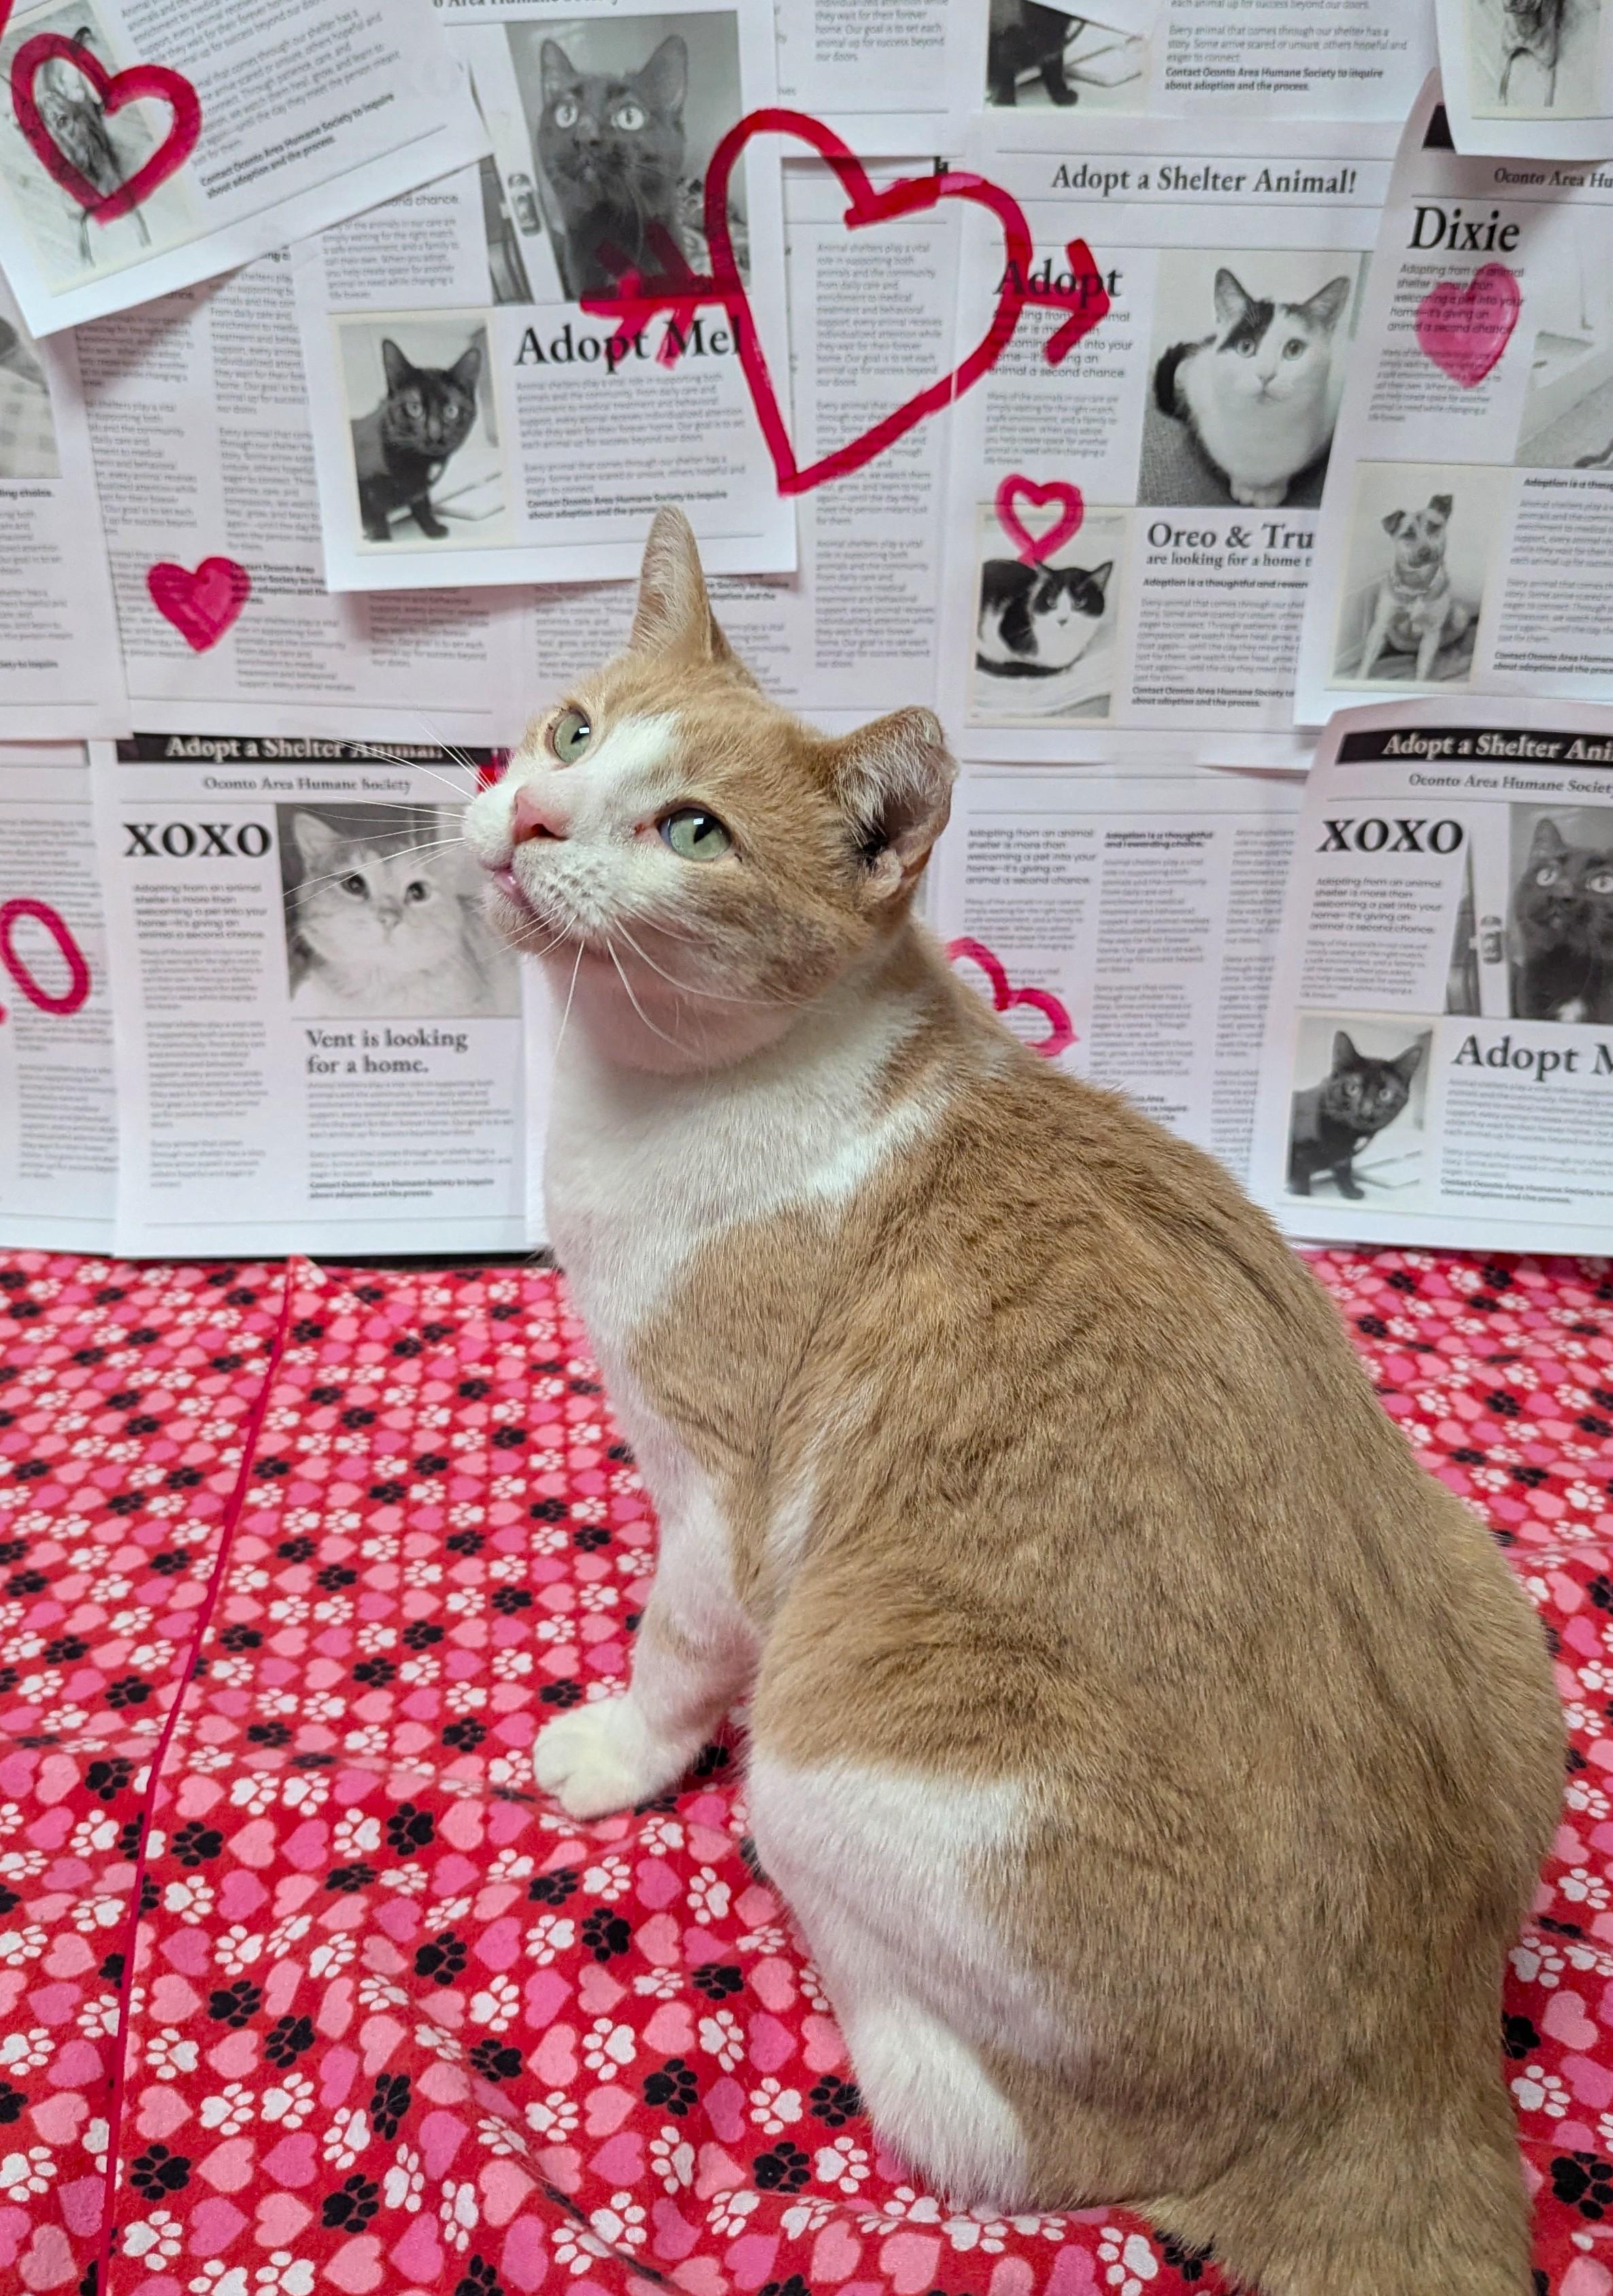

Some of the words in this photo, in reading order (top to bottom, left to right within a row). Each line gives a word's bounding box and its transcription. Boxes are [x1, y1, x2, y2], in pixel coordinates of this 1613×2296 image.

[1165, 68, 1201, 77] Contact
[1204, 69, 1236, 77] Oconto
[1238, 69, 1259, 77] Area
[1261, 69, 1301, 78] Humane
[1303, 69, 1335, 80] Society
[1337, 70, 1346, 78] to
[1165, 80, 1192, 90] about
[1194, 80, 1235, 92] adoption
[1237, 81, 1254, 90] and
[1257, 81, 1271, 90] the
[1051, 164, 1130, 197] Adopt
[1137, 174, 1148, 190] a
[1159, 167, 1246, 192] Shelter
[1252, 170, 1357, 195] Animal!
[1494, 168, 1544, 184] Oconto
[1548, 171, 1584, 187] Area
[1406, 206, 1520, 252] Dixie
[1400, 264, 1446, 277] Adopting
[1448, 266, 1470, 275] from
[992, 258, 1123, 308] Adopt
[514, 324, 651, 375] Adopt
[1084, 339, 1105, 349] into
[1108, 341, 1133, 353] your
[1084, 354, 1099, 363] an
[1040, 367, 1080, 377] second
[1147, 522, 1217, 548] Oreo
[1225, 526, 1252, 549] &
[1261, 522, 1314, 550] Tru
[1146, 555, 1167, 565] are
[1171, 552, 1223, 570] looking
[1227, 553, 1248, 567] for
[1250, 558, 1259, 567] a
[1263, 554, 1301, 567] home
[1143, 578, 1186, 589] Adoption
[1205, 579, 1255, 590] thoughtful
[1257, 580, 1276, 589] and
[1132, 686, 1163, 694] Contact
[1196, 687, 1215, 696] Area
[1217, 688, 1253, 696] Humane
[1254, 688, 1284, 698] Society
[1131, 696, 1155, 705] about
[1157, 696, 1194, 707] adoption
[1195, 698, 1212, 706] and
[1212, 698, 1227, 707] the
[165, 735, 241, 763] Adopt
[244, 742, 258, 758] a
[262, 737, 342, 758] Shelter
[1382, 732, 1452, 761] Adopt
[1458, 739, 1473, 755] a
[1476, 734, 1563, 759] Shelter
[203, 777, 256, 790] Oconto
[263, 777, 293, 790] Area
[299, 778, 357, 791] Humane
[362, 778, 412, 794] Society
[1409, 773, 1461, 787] Oconto
[1465, 775, 1498, 788] Area
[1502, 776, 1563, 791] Humane
[1567, 780, 1613, 799] Societ
[123, 822, 271, 858] XOXO
[1016, 828, 1039, 838] from
[1057, 828, 1093, 838] animal
[1316, 819, 1463, 855] XOXO
[1043, 840, 1065, 849] than
[967, 851, 1022, 864] welcoming
[1033, 852, 1050, 864] pet
[1053, 852, 1071, 862] into
[1074, 854, 1097, 864] your
[1021, 864, 1050, 876] giving
[1054, 866, 1066, 874] an
[965, 875, 1001, 885] animal
[1012, 875, 1050, 885] second
[305, 1028, 355, 1048] Vent
[362, 1029, 380, 1048] is
[384, 1027, 469, 1053] looking
[307, 1055, 339, 1074] for
[346, 1061, 357, 1074] a
[364, 1055, 429, 1074] home.
[1450, 1034, 1579, 1082] Adopt
